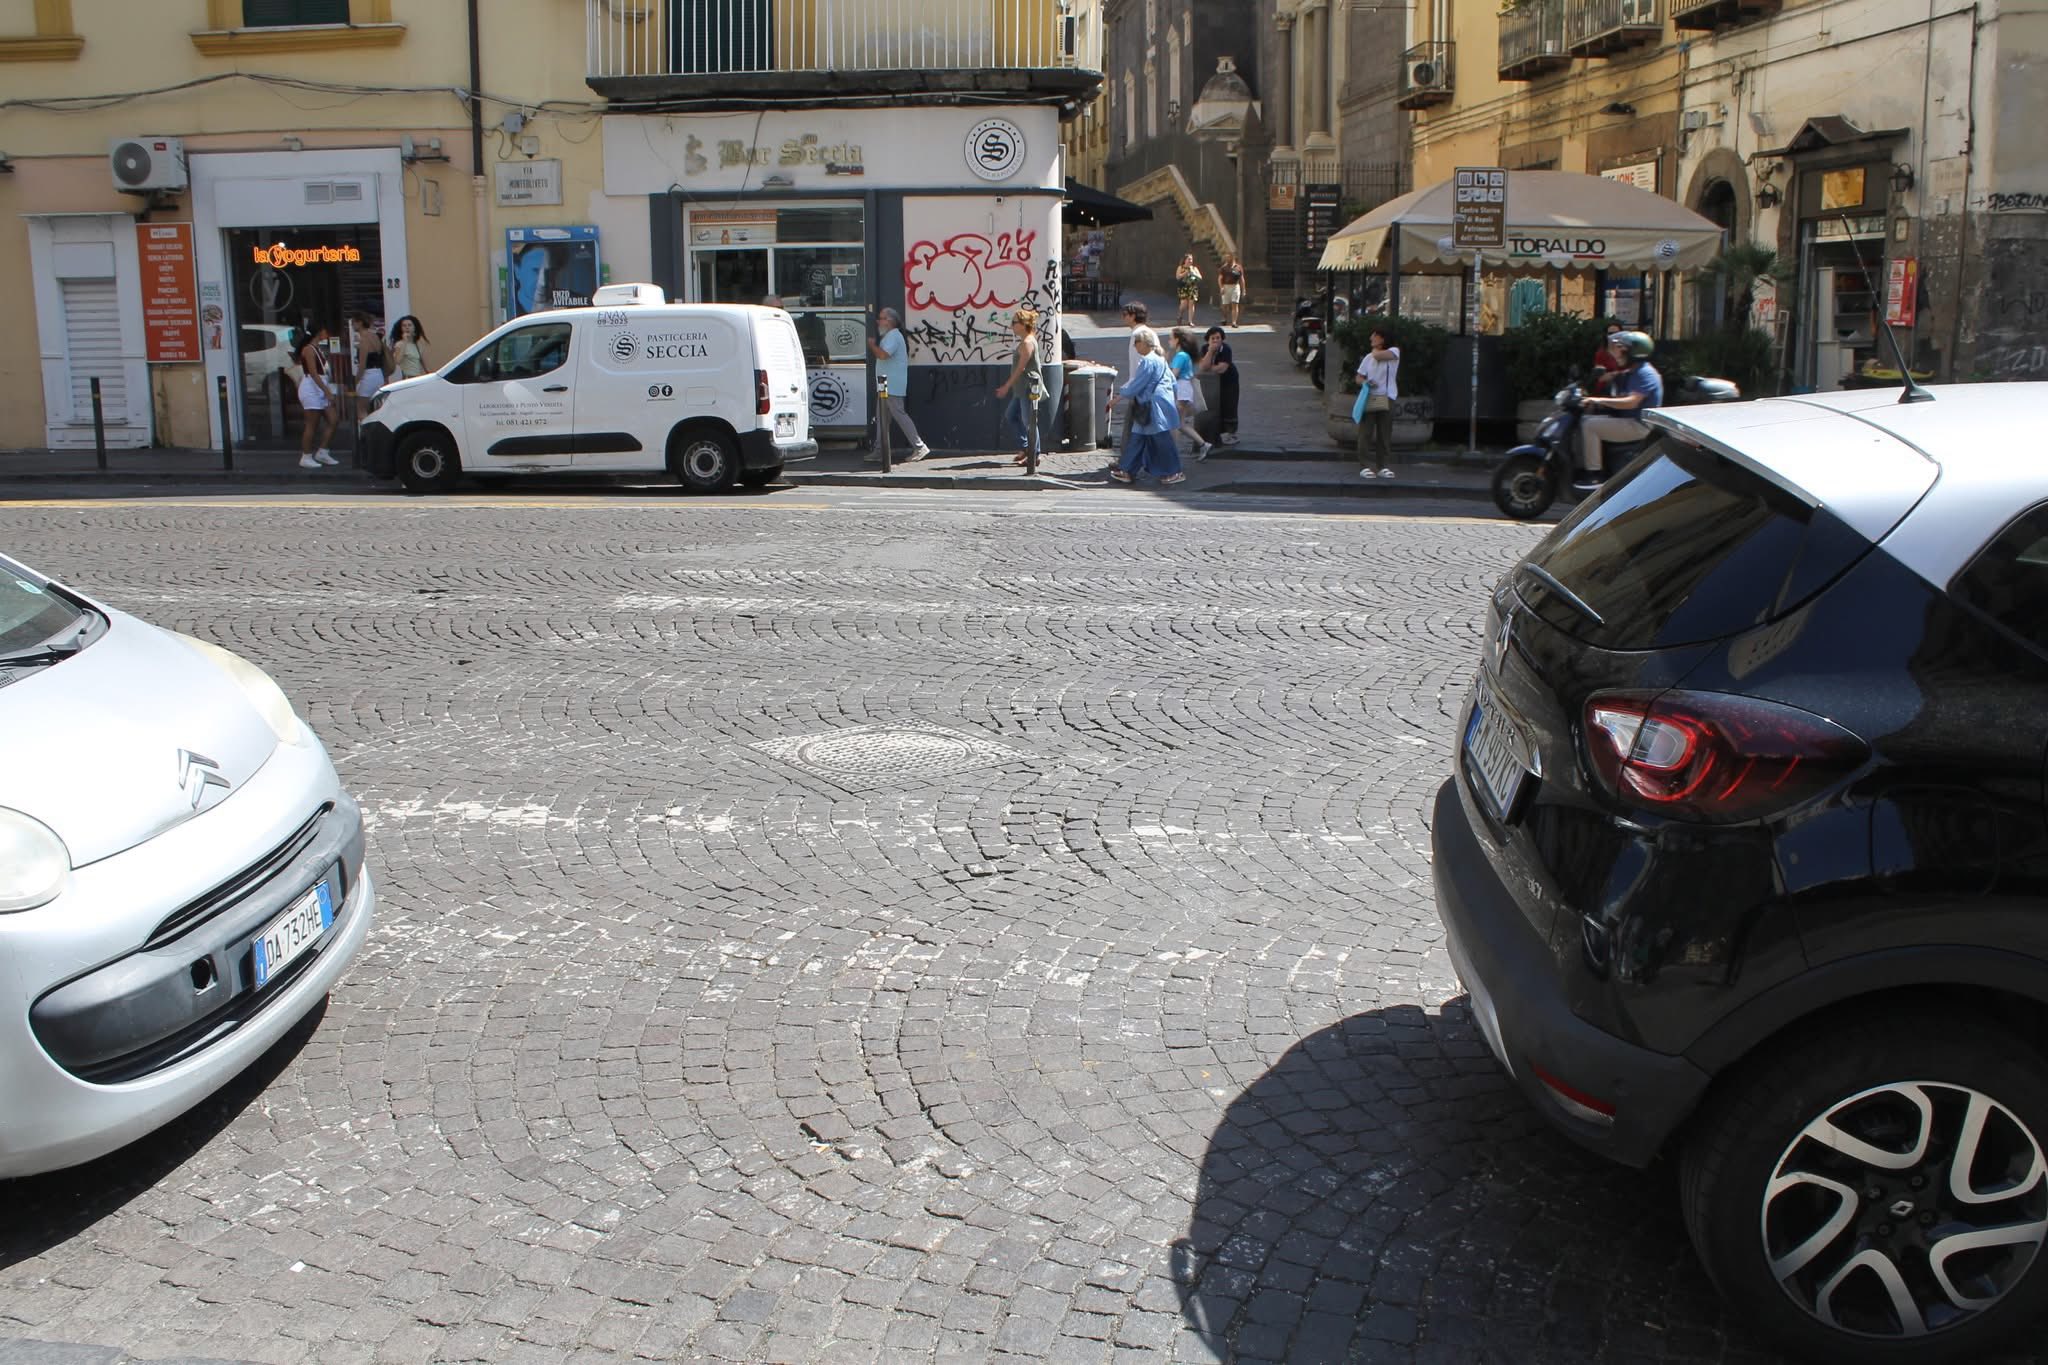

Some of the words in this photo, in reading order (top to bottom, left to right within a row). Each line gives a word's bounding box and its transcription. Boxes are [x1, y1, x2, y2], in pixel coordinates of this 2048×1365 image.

[1508, 238, 1606, 254] TORALDO
[254, 246, 269, 263] la
[270, 244, 361, 267] yogurteria
[552, 290, 570, 298] ENZO
[552, 297, 588, 306] AVITABILE
[647, 332, 708, 342] PASTICCERIA
[646, 344, 708, 359] SECCIA
[283, 900, 322, 955] 732HE
